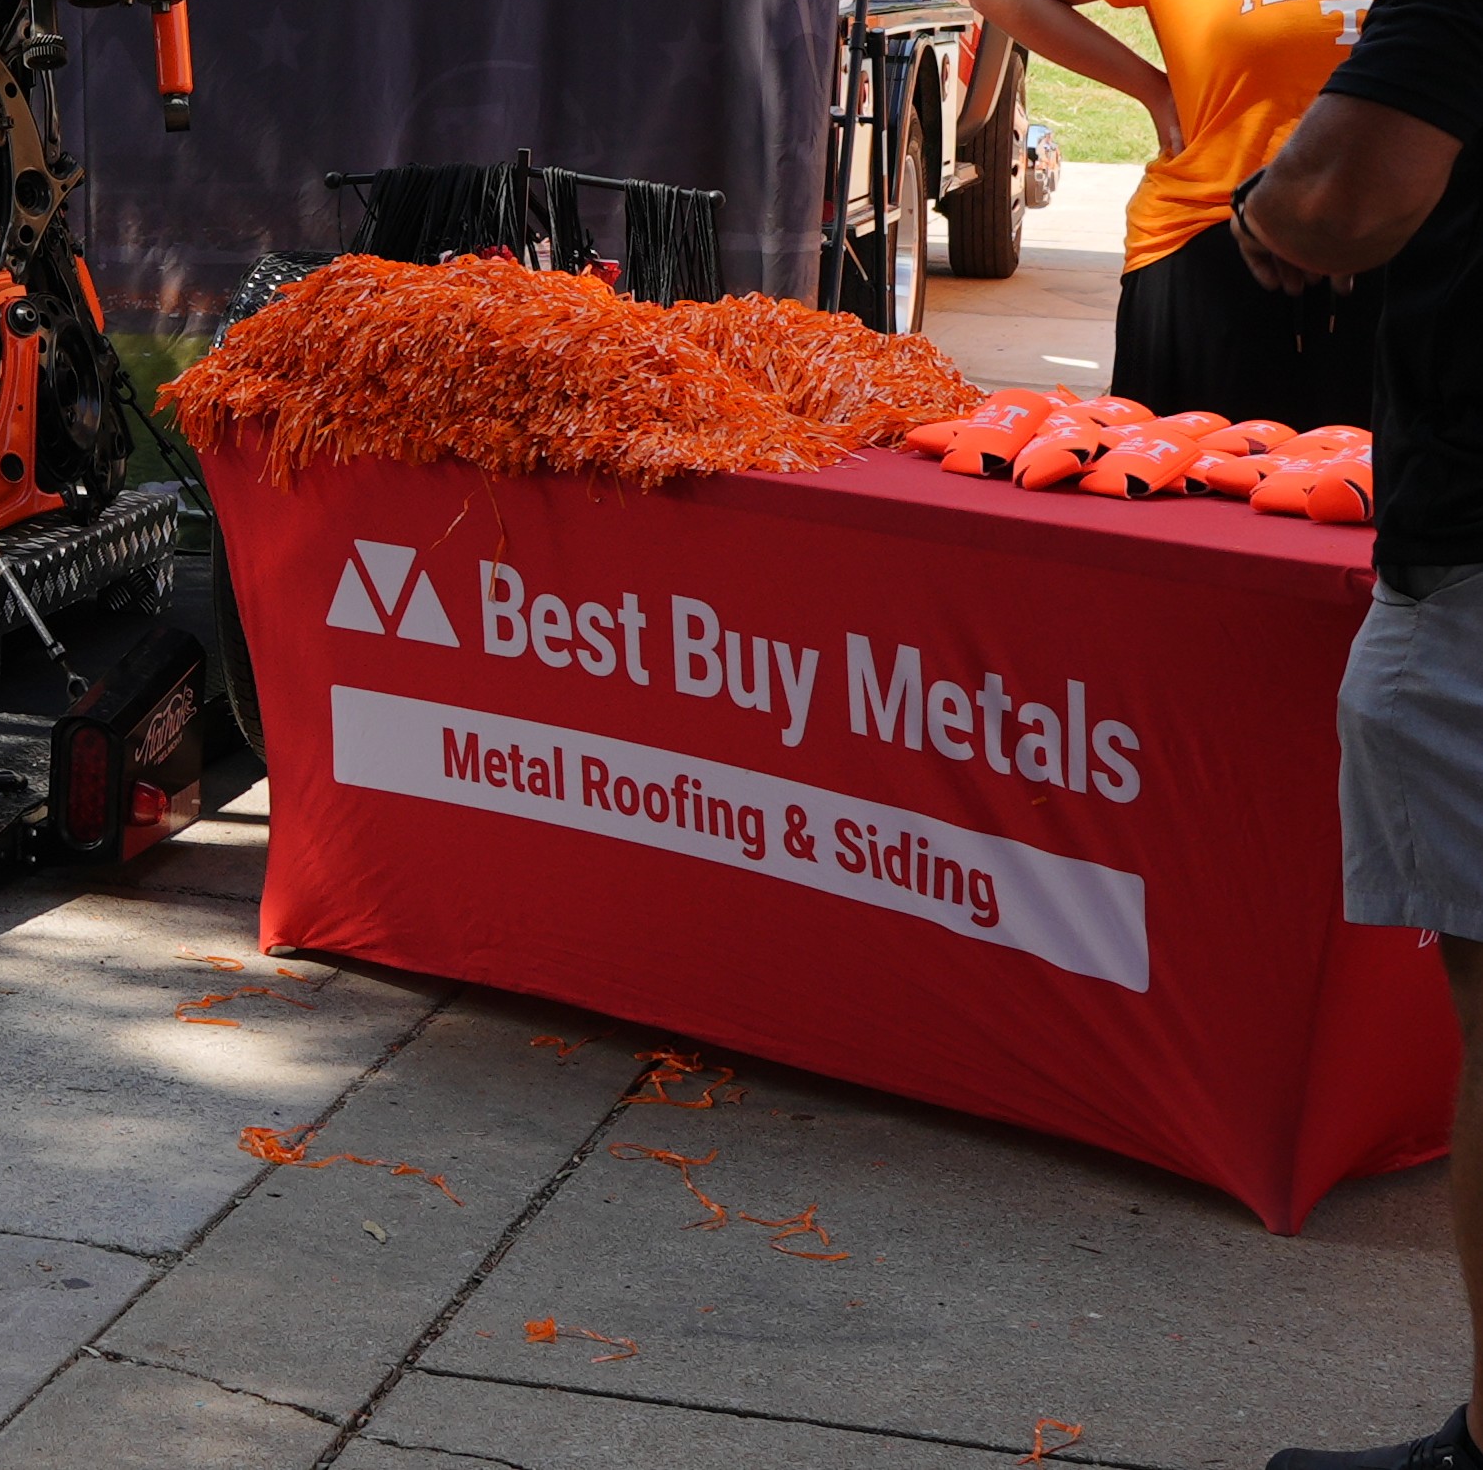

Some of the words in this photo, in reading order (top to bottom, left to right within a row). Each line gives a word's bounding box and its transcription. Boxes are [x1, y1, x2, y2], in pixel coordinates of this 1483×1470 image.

[479, 559, 651, 687] Best
[671, 595, 821, 749] Buy
[846, 631, 1142, 805] Metals
[442, 728, 565, 802] Metal
[581, 754, 767, 862] Roofing
[783, 805, 819, 863] &
[834, 818, 1001, 929] Siding
